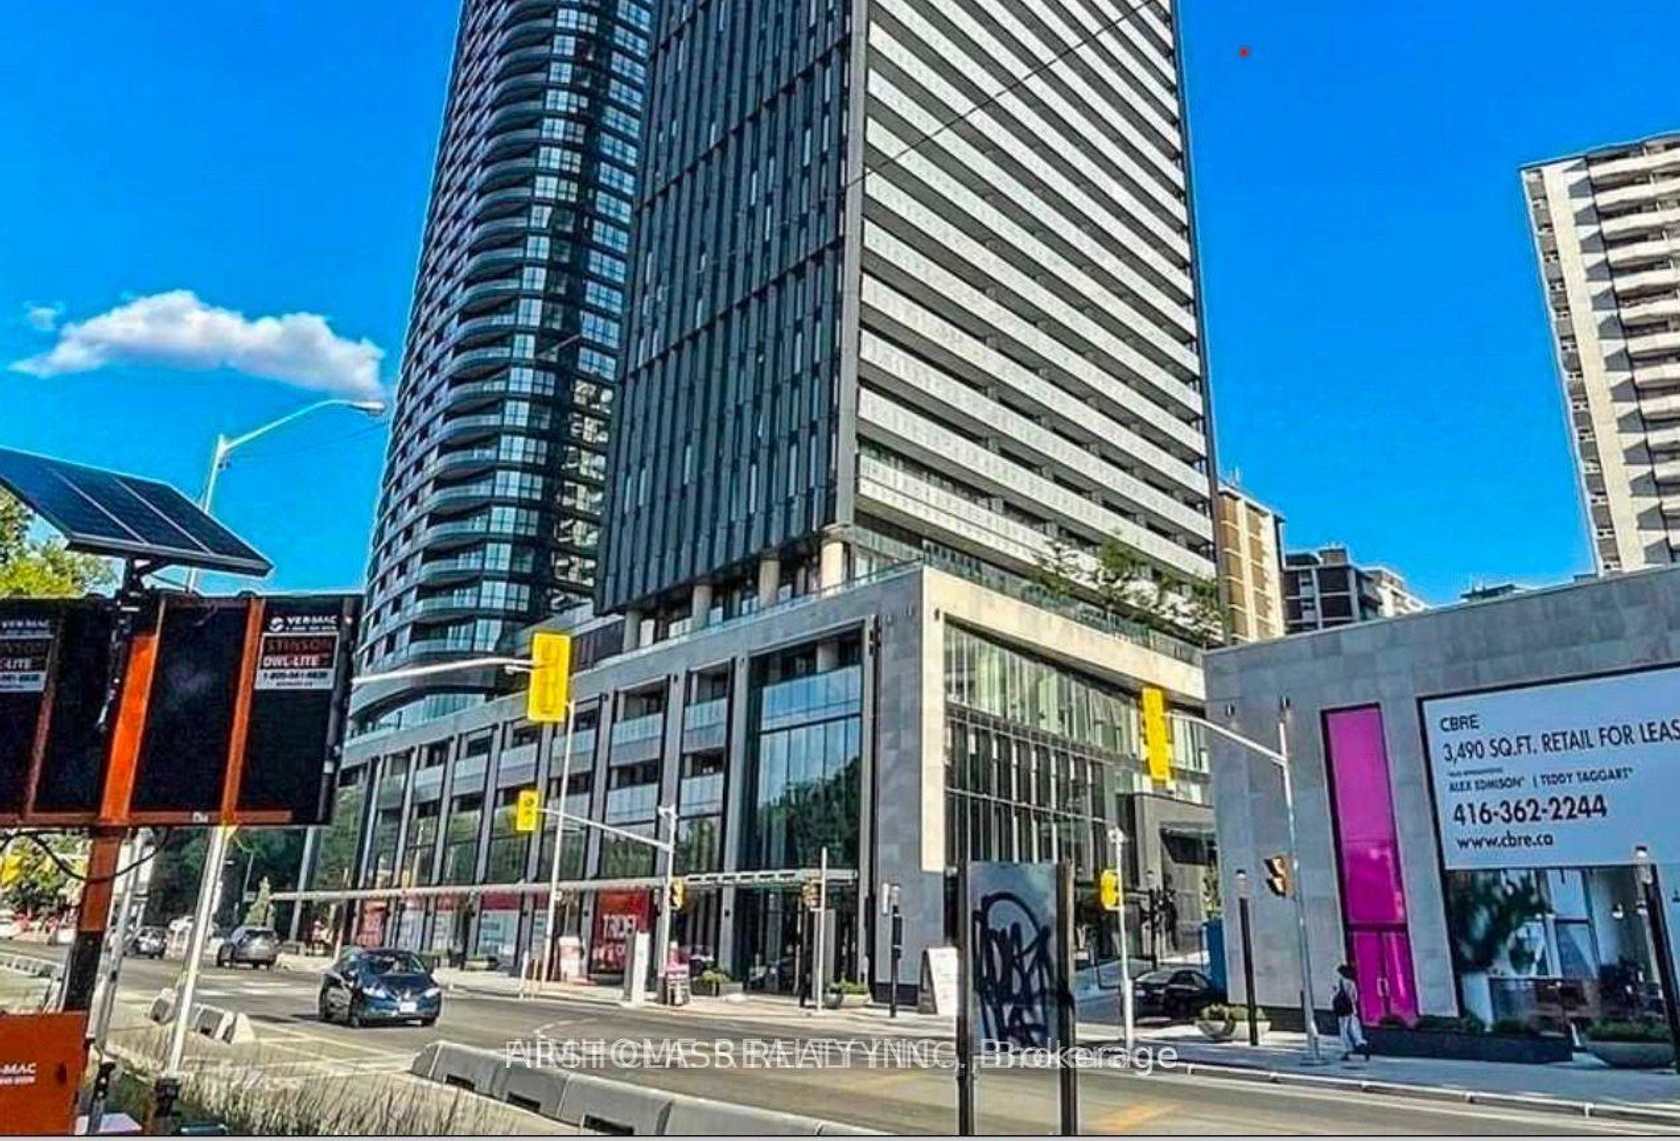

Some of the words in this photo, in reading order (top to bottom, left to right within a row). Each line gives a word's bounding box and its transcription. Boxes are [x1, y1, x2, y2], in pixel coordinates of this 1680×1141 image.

[1440, 714, 1480, 732] CBRE
[1443, 740, 1485, 765] 3,490
[1489, 735, 1538, 758] SQ.FT.
[1541, 729, 1595, 752] RETAIL
[1598, 724, 1635, 747] FOR
[1454, 794, 1608, 827] 416-362-2244
[1457, 831, 1554, 849] www.cbre.ca
